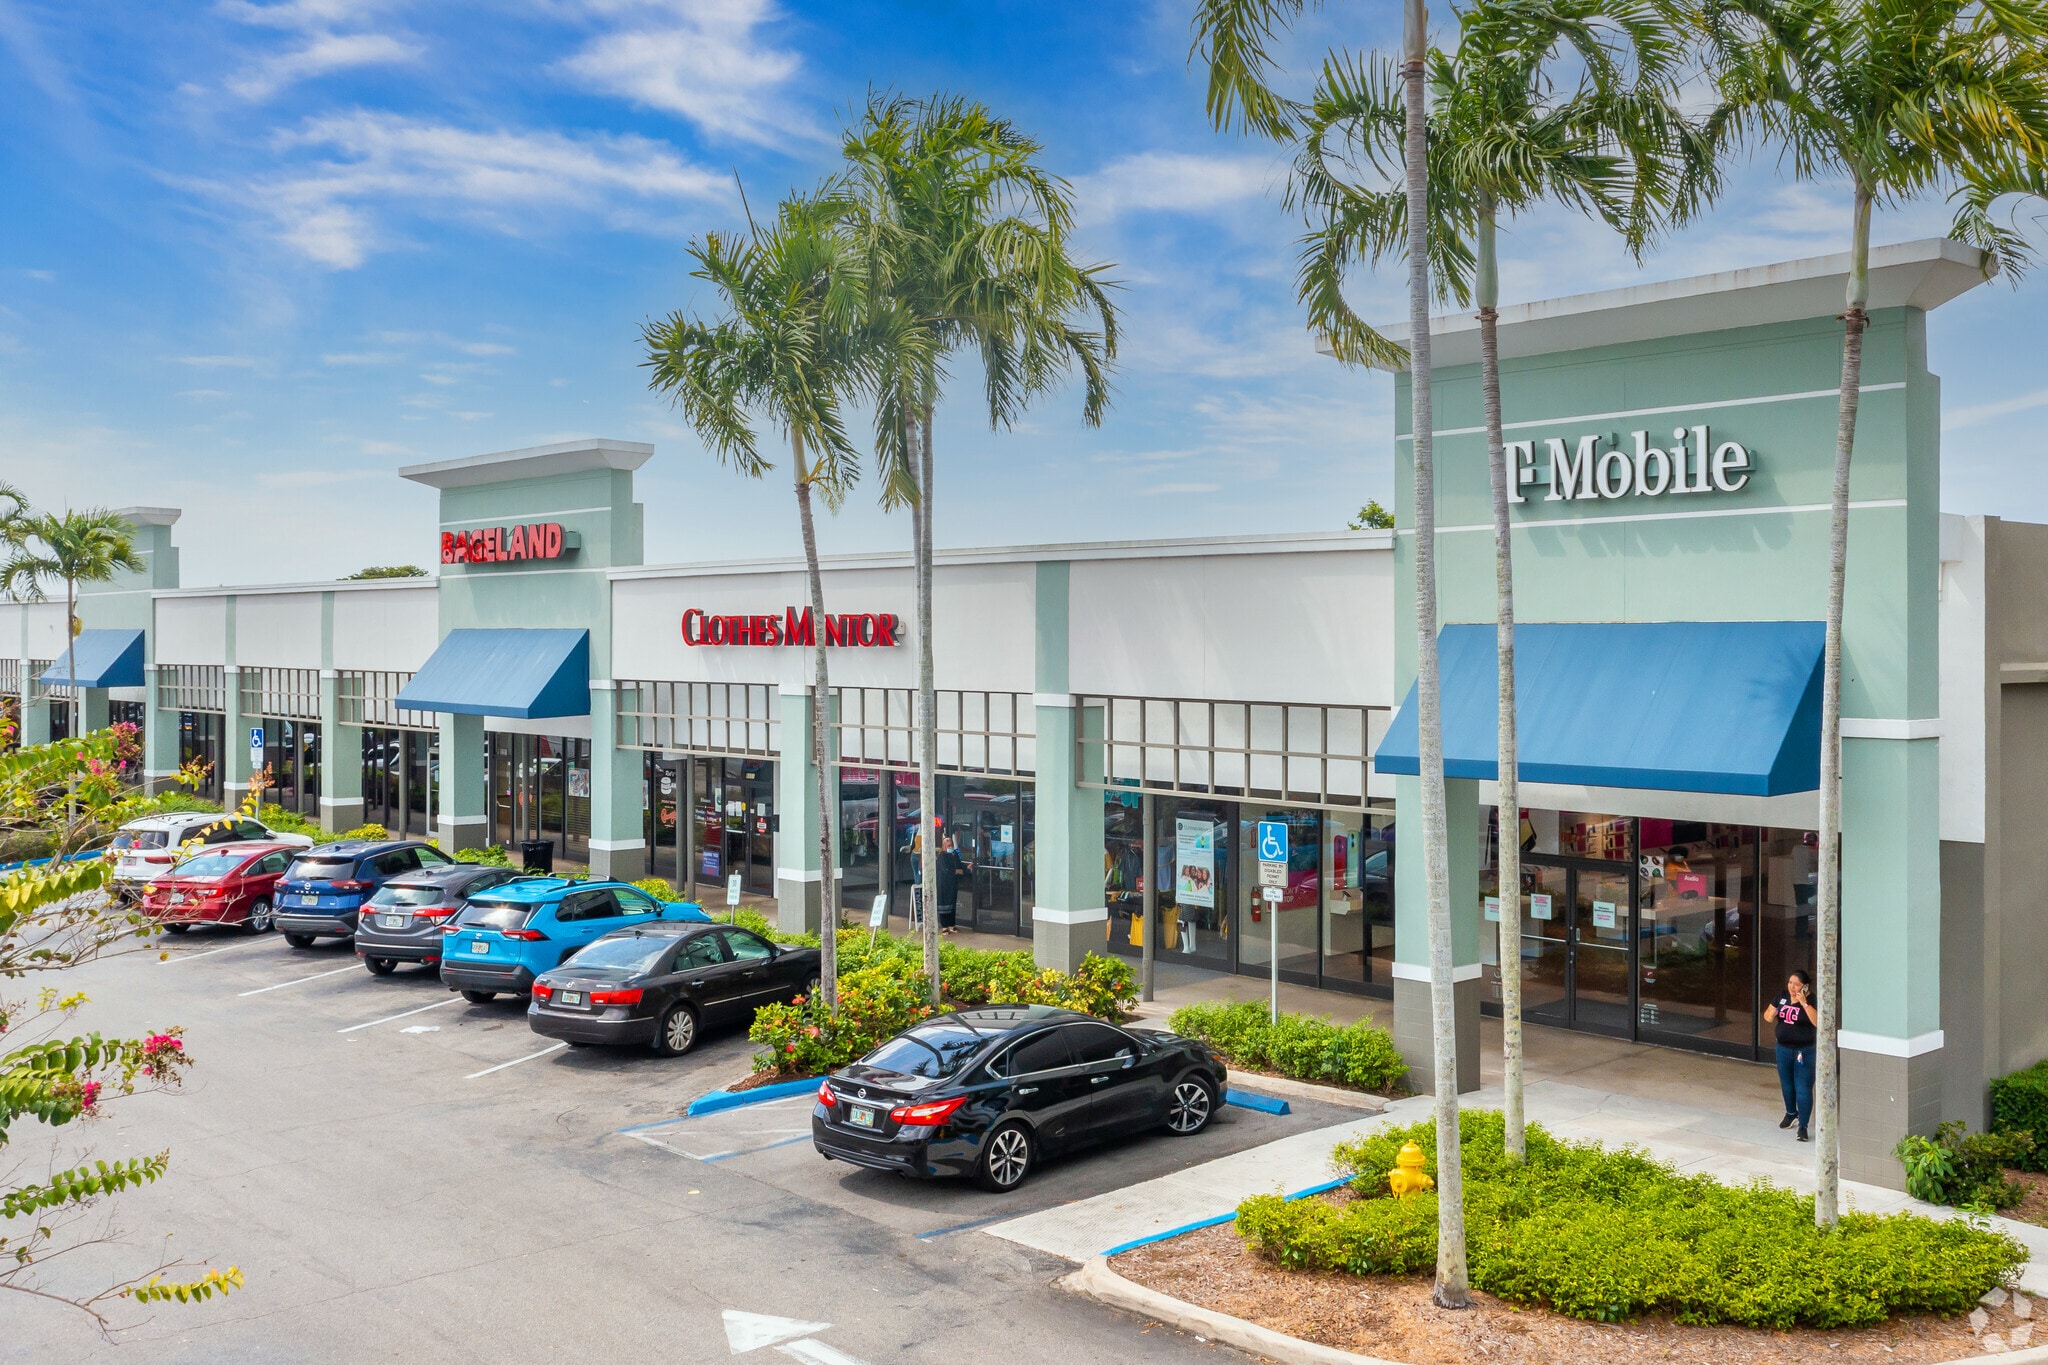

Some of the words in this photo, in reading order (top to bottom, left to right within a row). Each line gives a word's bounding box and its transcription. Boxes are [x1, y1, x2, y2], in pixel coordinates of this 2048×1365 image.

[441, 523, 564, 564] BAGELAND
[682, 608, 782, 647] CLOTHES
[784, 605, 899, 648] MNTOR
[1779, 1005, 1800, 1024] T
